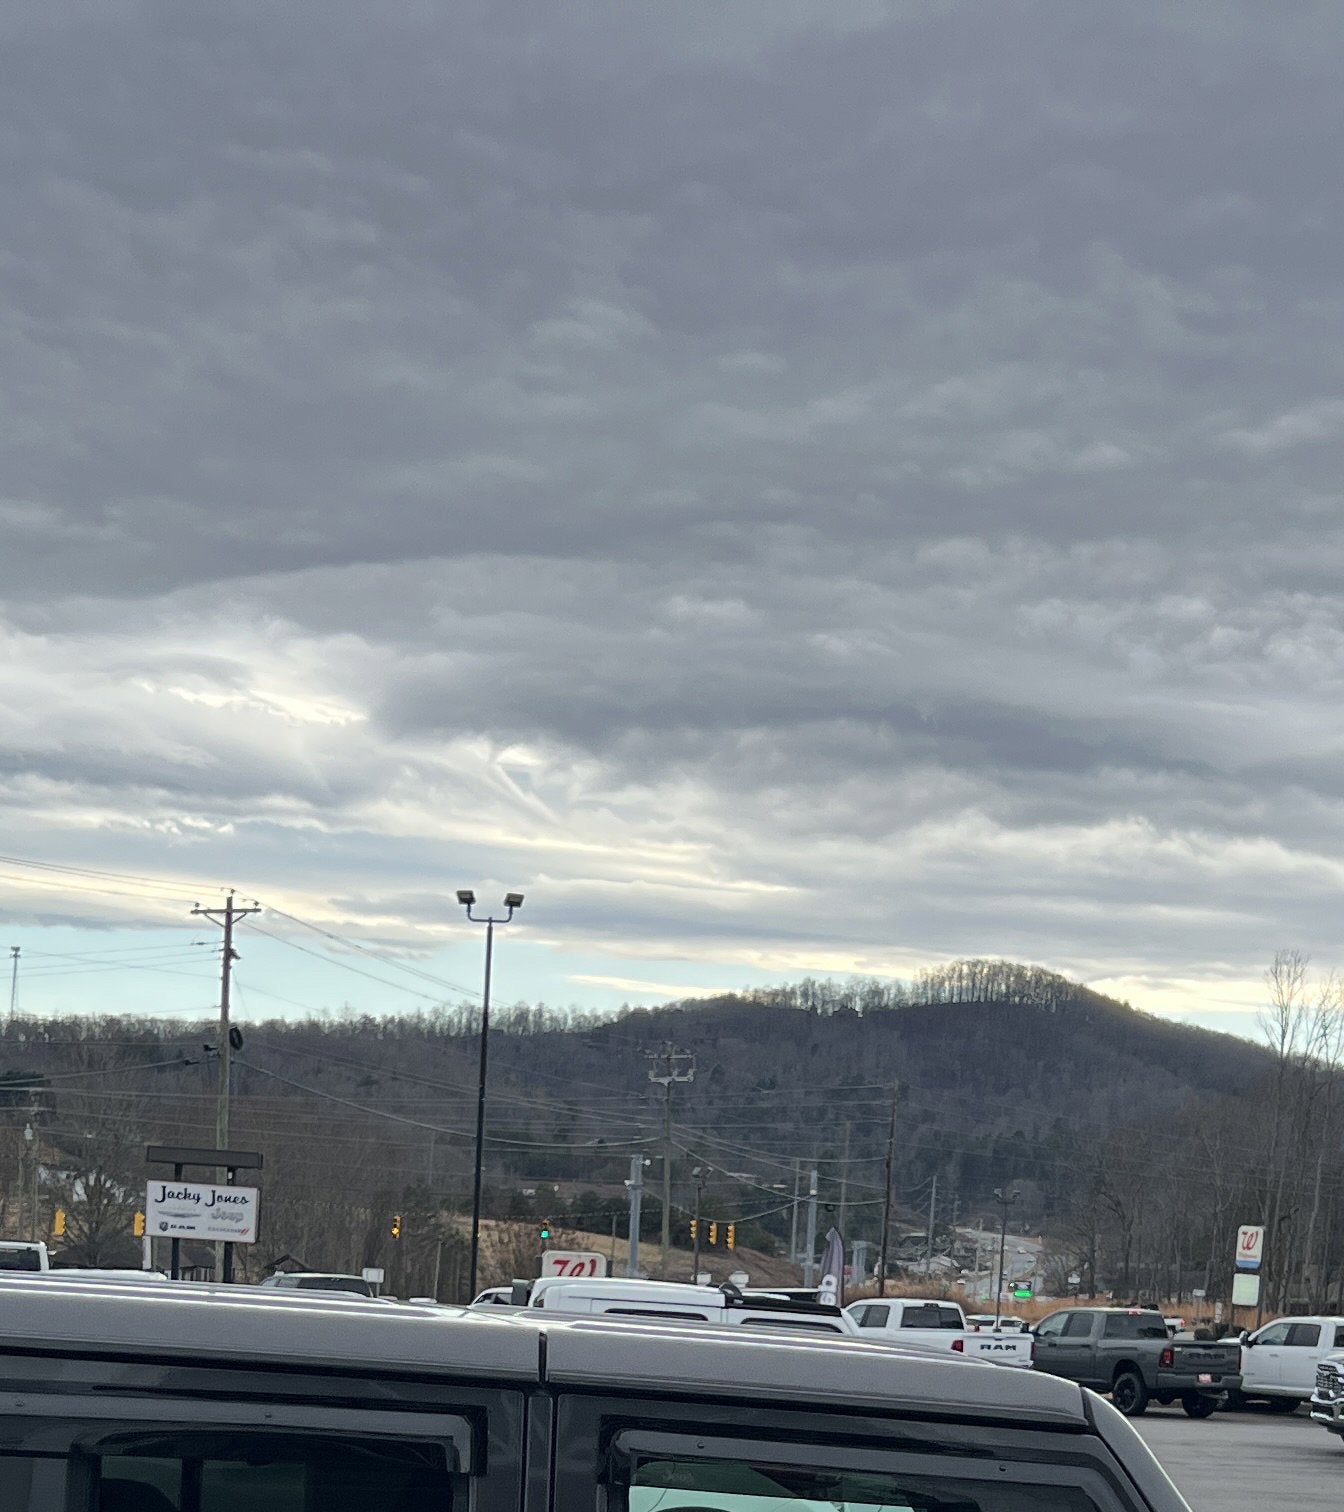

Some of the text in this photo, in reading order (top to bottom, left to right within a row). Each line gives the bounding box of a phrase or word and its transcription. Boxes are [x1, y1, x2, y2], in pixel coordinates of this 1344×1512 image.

[154, 1185, 250, 1207] Jacky Jones
[980, 1343, 1018, 1352] RAM
